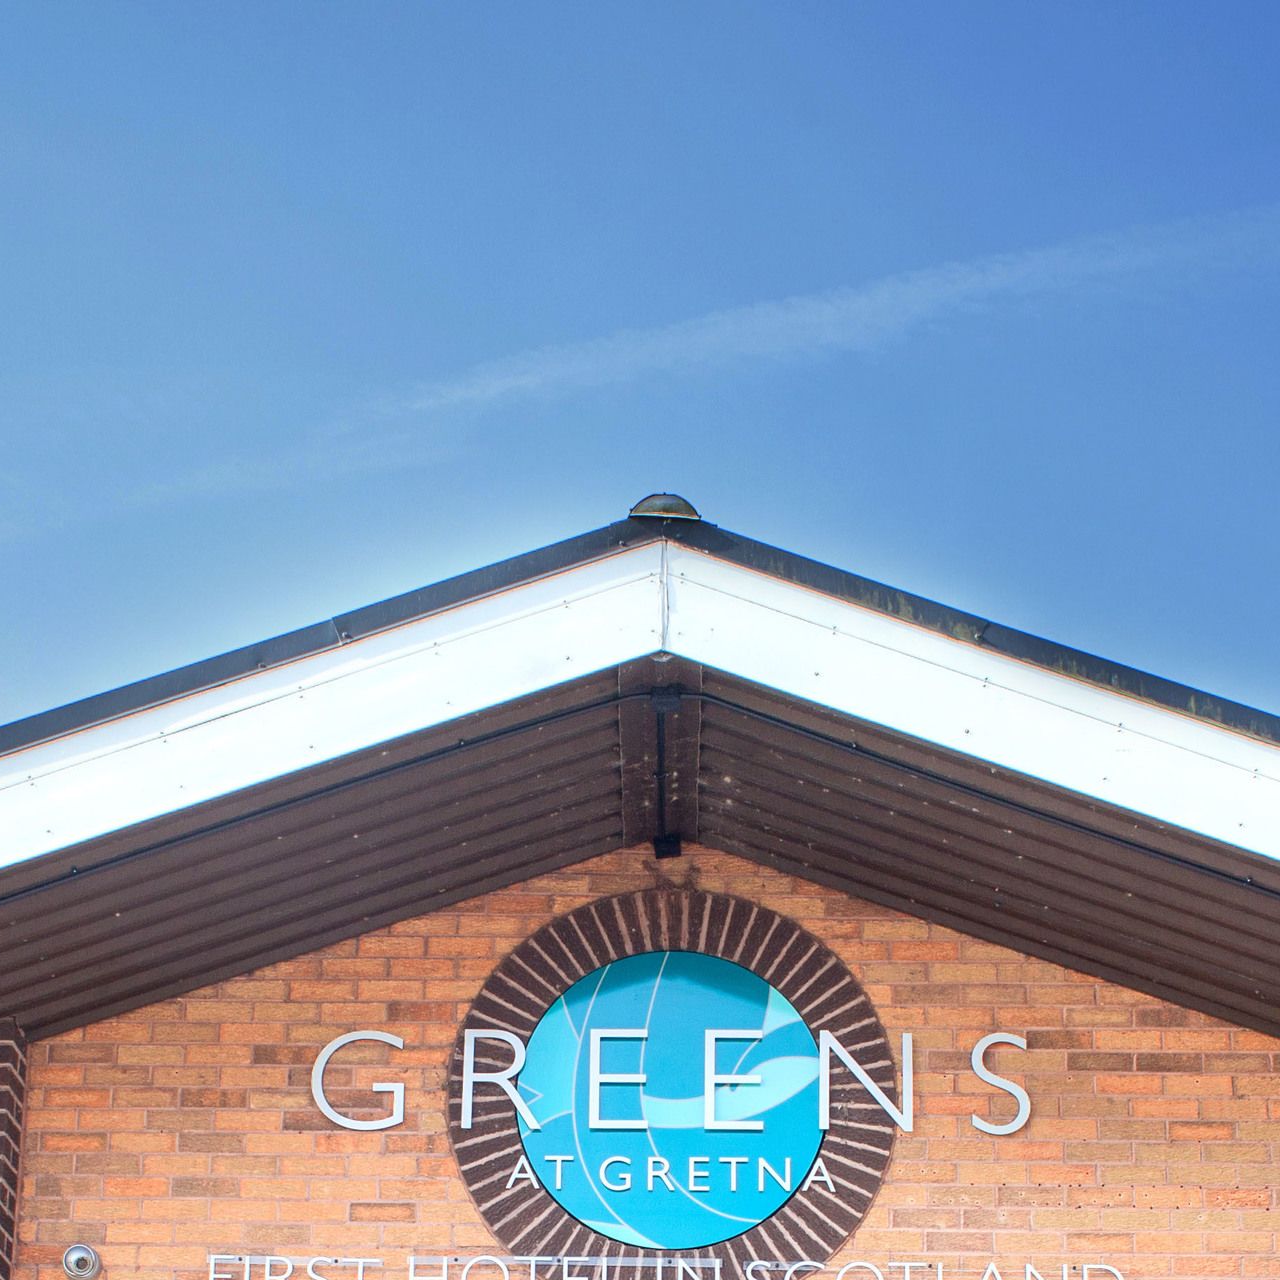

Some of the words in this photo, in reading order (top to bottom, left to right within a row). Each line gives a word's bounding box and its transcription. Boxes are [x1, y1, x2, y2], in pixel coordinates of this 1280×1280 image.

[311, 1028, 1031, 1135] GREENS
[506, 1155, 574, 1192] AT
[598, 1155, 838, 1194] GRETNA
